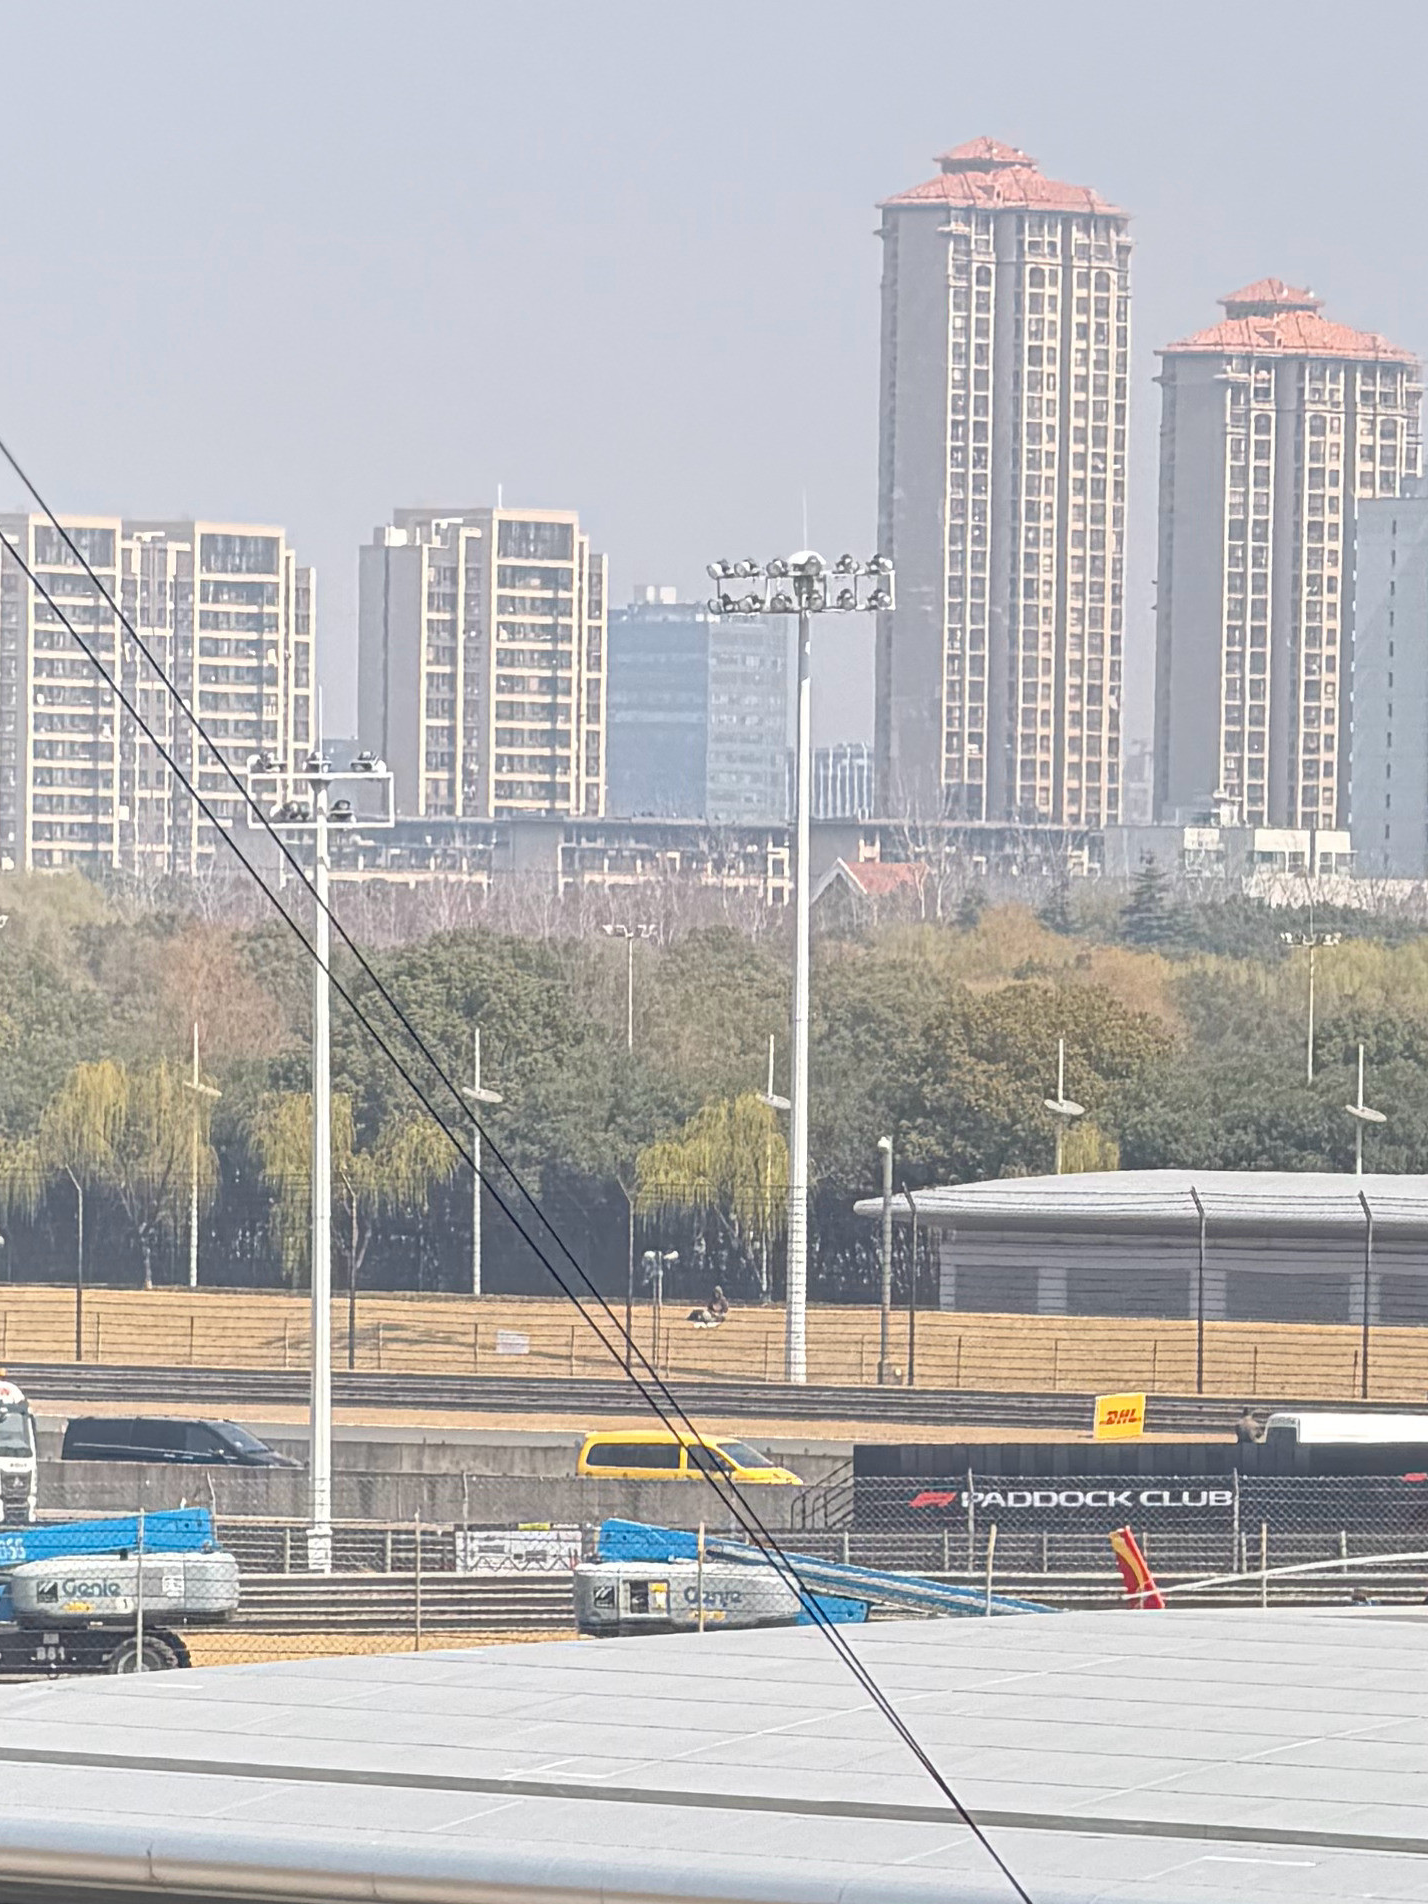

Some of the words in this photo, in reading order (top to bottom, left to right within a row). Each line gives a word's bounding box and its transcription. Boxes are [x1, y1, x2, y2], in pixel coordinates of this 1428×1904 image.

[1099, 1408, 1141, 1426] DHL
[960, 1490, 1133, 1508] PADDOCK
[1139, 1490, 1233, 1507] CLUB
[61, 1578, 122, 1597] Genie
